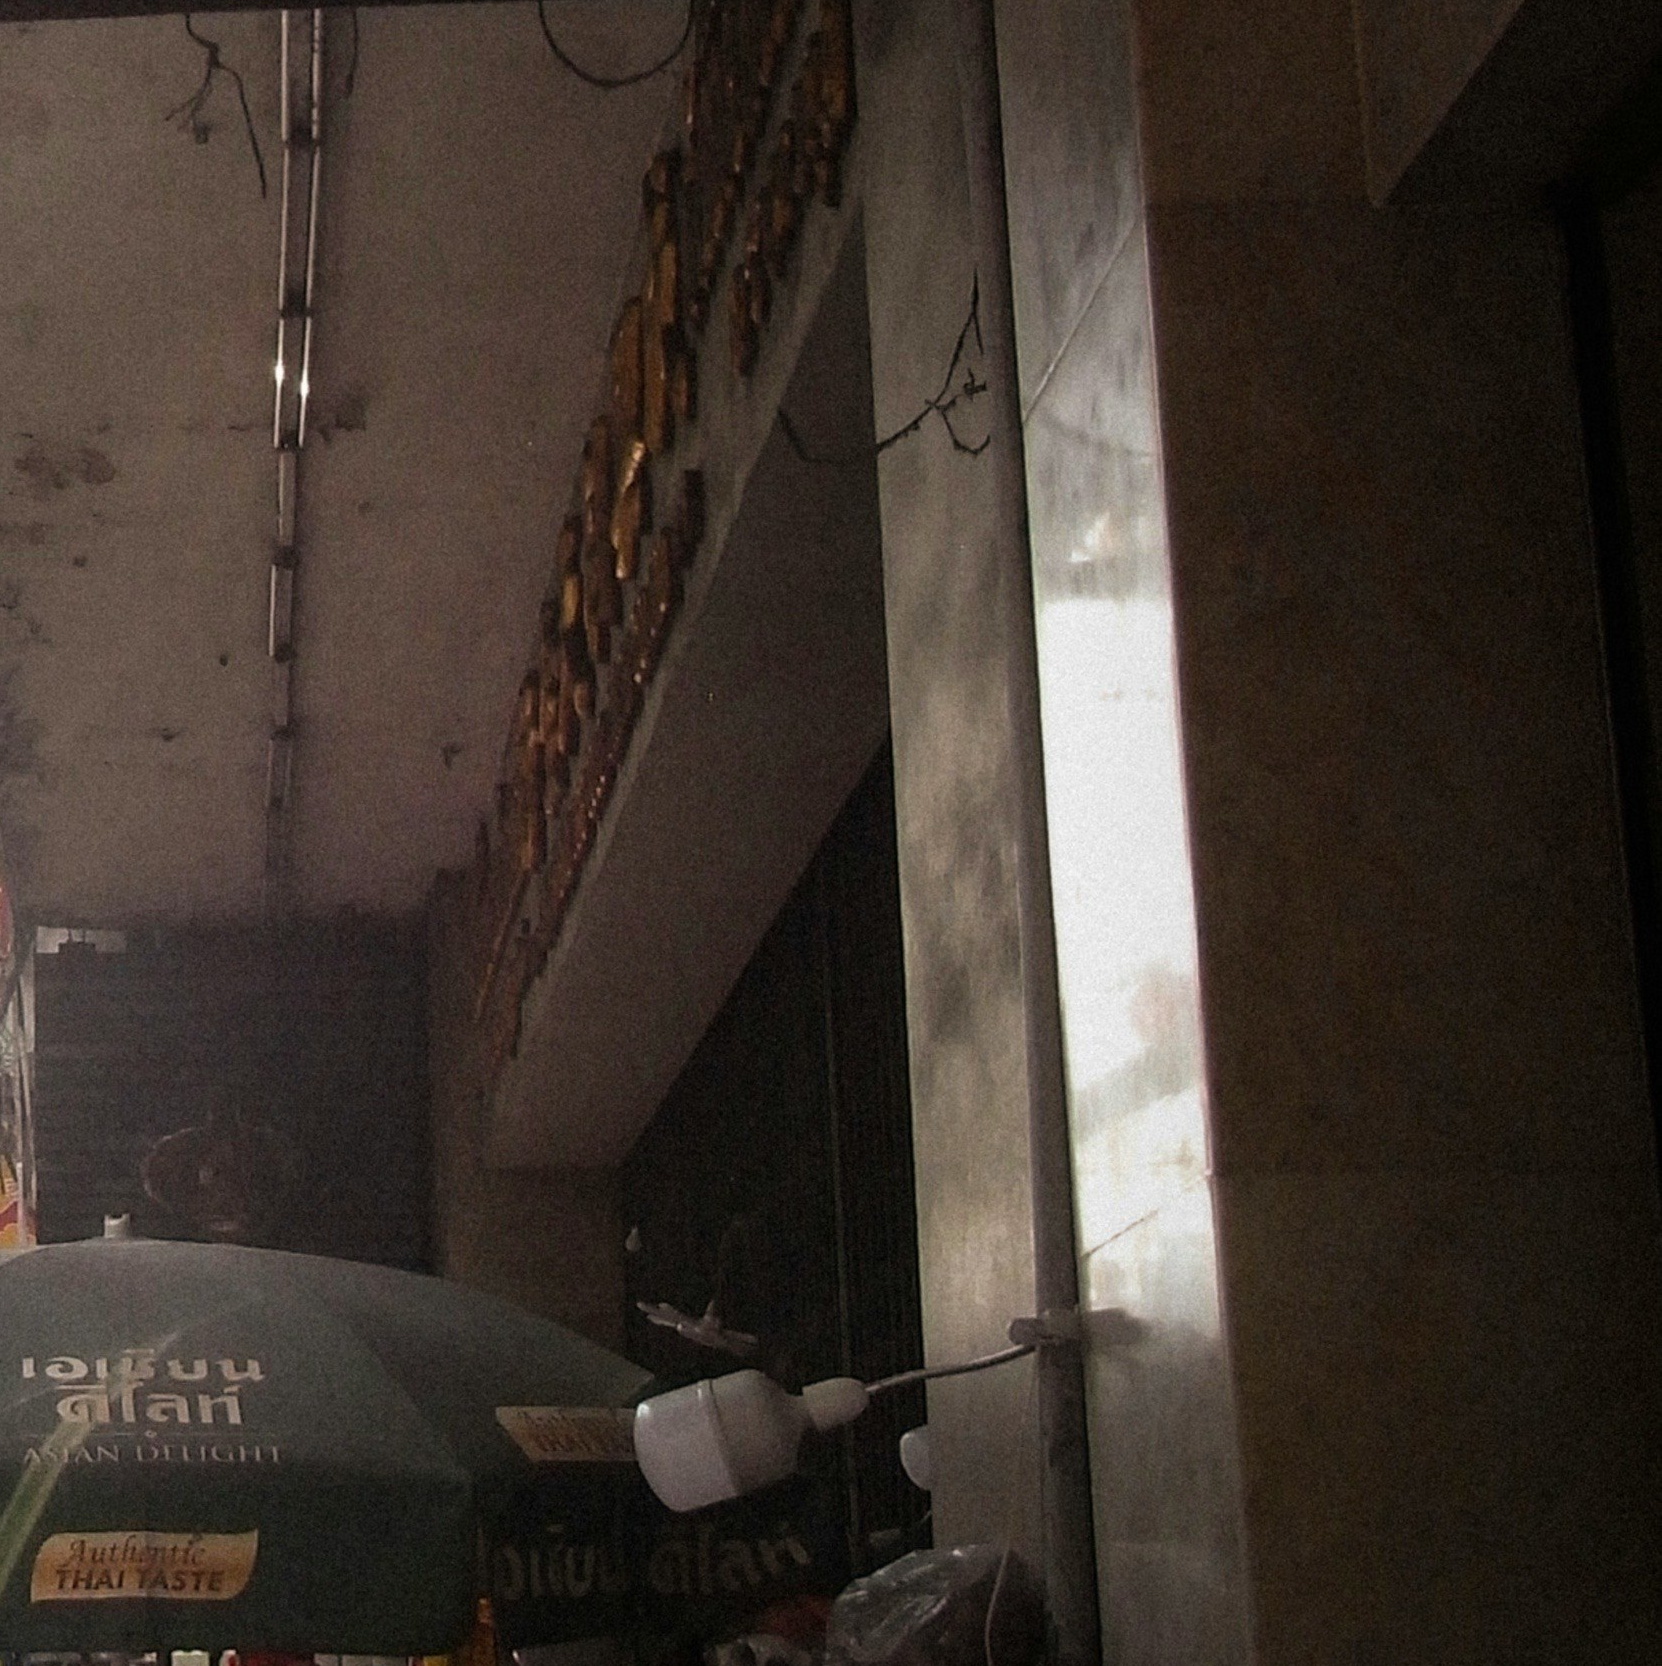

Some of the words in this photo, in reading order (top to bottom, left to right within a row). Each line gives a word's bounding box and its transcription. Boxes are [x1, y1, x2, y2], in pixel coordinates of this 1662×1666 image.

[22, 1348, 265, 1381] เอเชียน
[54, 1380, 244, 1426] ดีไลท์
[23, 1444, 120, 1464] ASIAN
[136, 1443, 281, 1465] DELIGHT
[58, 1534, 207, 1569] Authentic
[55, 1569, 126, 1591] THAI
[138, 1568, 226, 1592] TASTE
